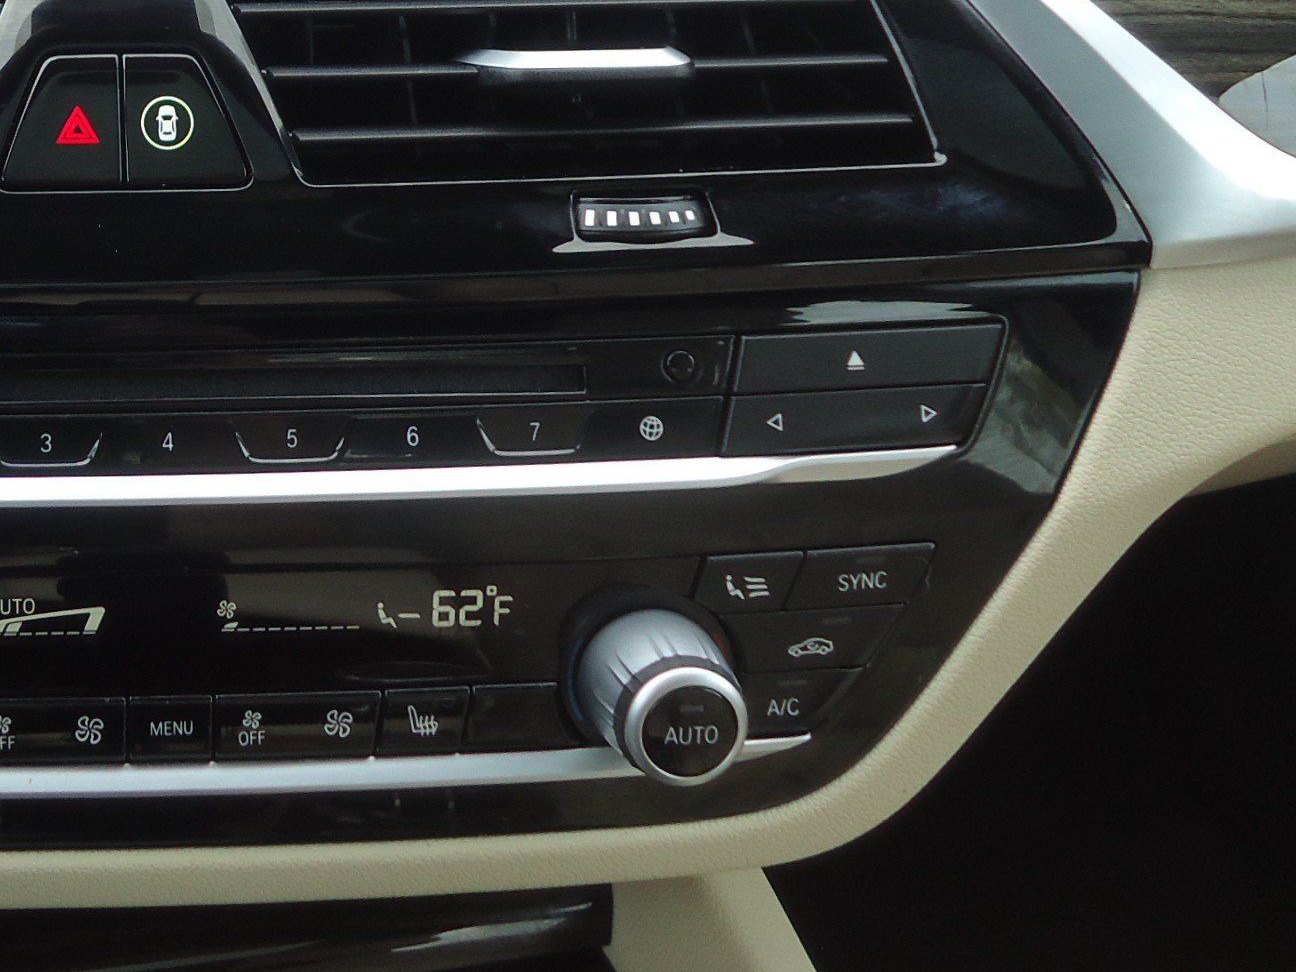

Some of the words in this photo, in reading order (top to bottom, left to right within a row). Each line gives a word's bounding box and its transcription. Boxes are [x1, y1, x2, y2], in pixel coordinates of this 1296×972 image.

[161, 432, 175, 452] 4
[287, 428, 298, 450] 5
[406, 426, 419, 447] 6
[529, 422, 541, 443] 7
[40, 434, 52, 453] 3
[838, 571, 888, 592] SYNC
[767, 698, 799, 717] A/C
[149, 720, 194, 736] MENU
[664, 725, 719, 745] AUTO
[238, 730, 265, 747] OFF
